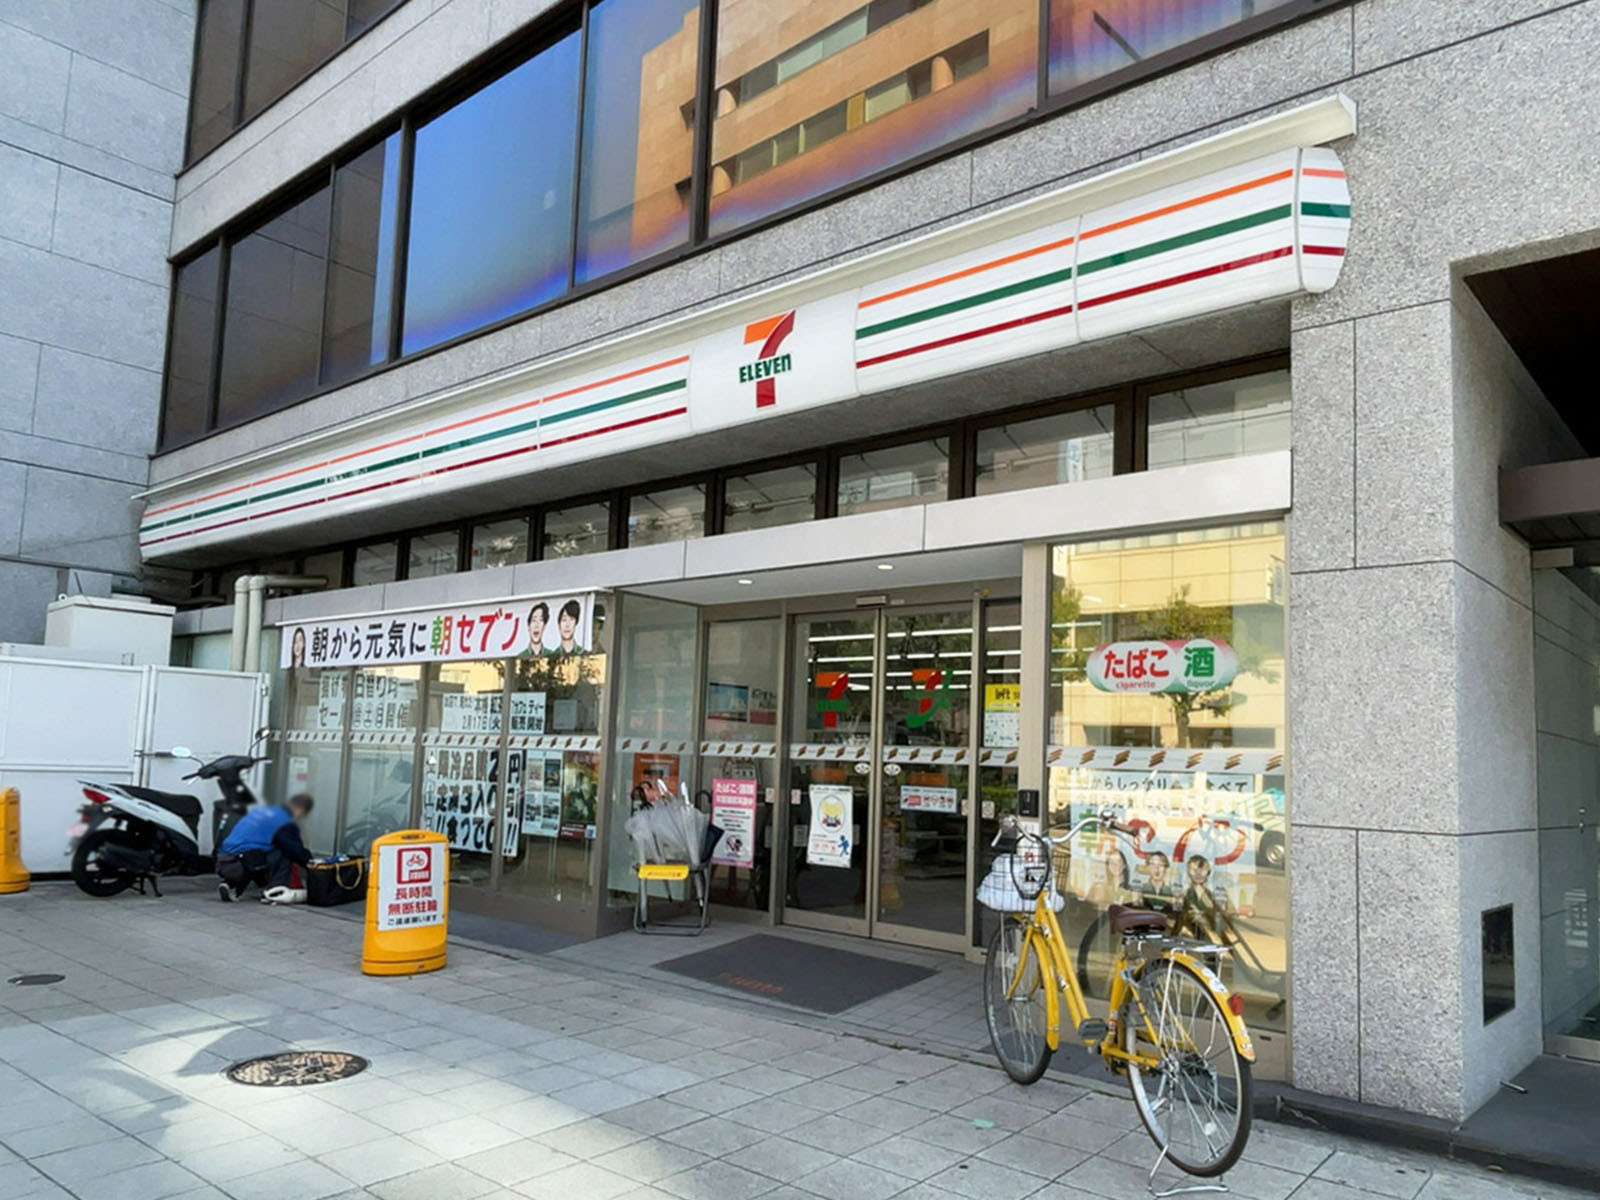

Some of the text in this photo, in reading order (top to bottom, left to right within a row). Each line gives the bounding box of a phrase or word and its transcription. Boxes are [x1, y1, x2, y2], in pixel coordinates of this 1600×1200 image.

[743, 309, 796, 408] 7
[311, 608, 520, 662] 朝から元気に朝セブン
[1104, 646, 1215, 679] たばこ 酒
[395, 886, 432, 900] 長時間
